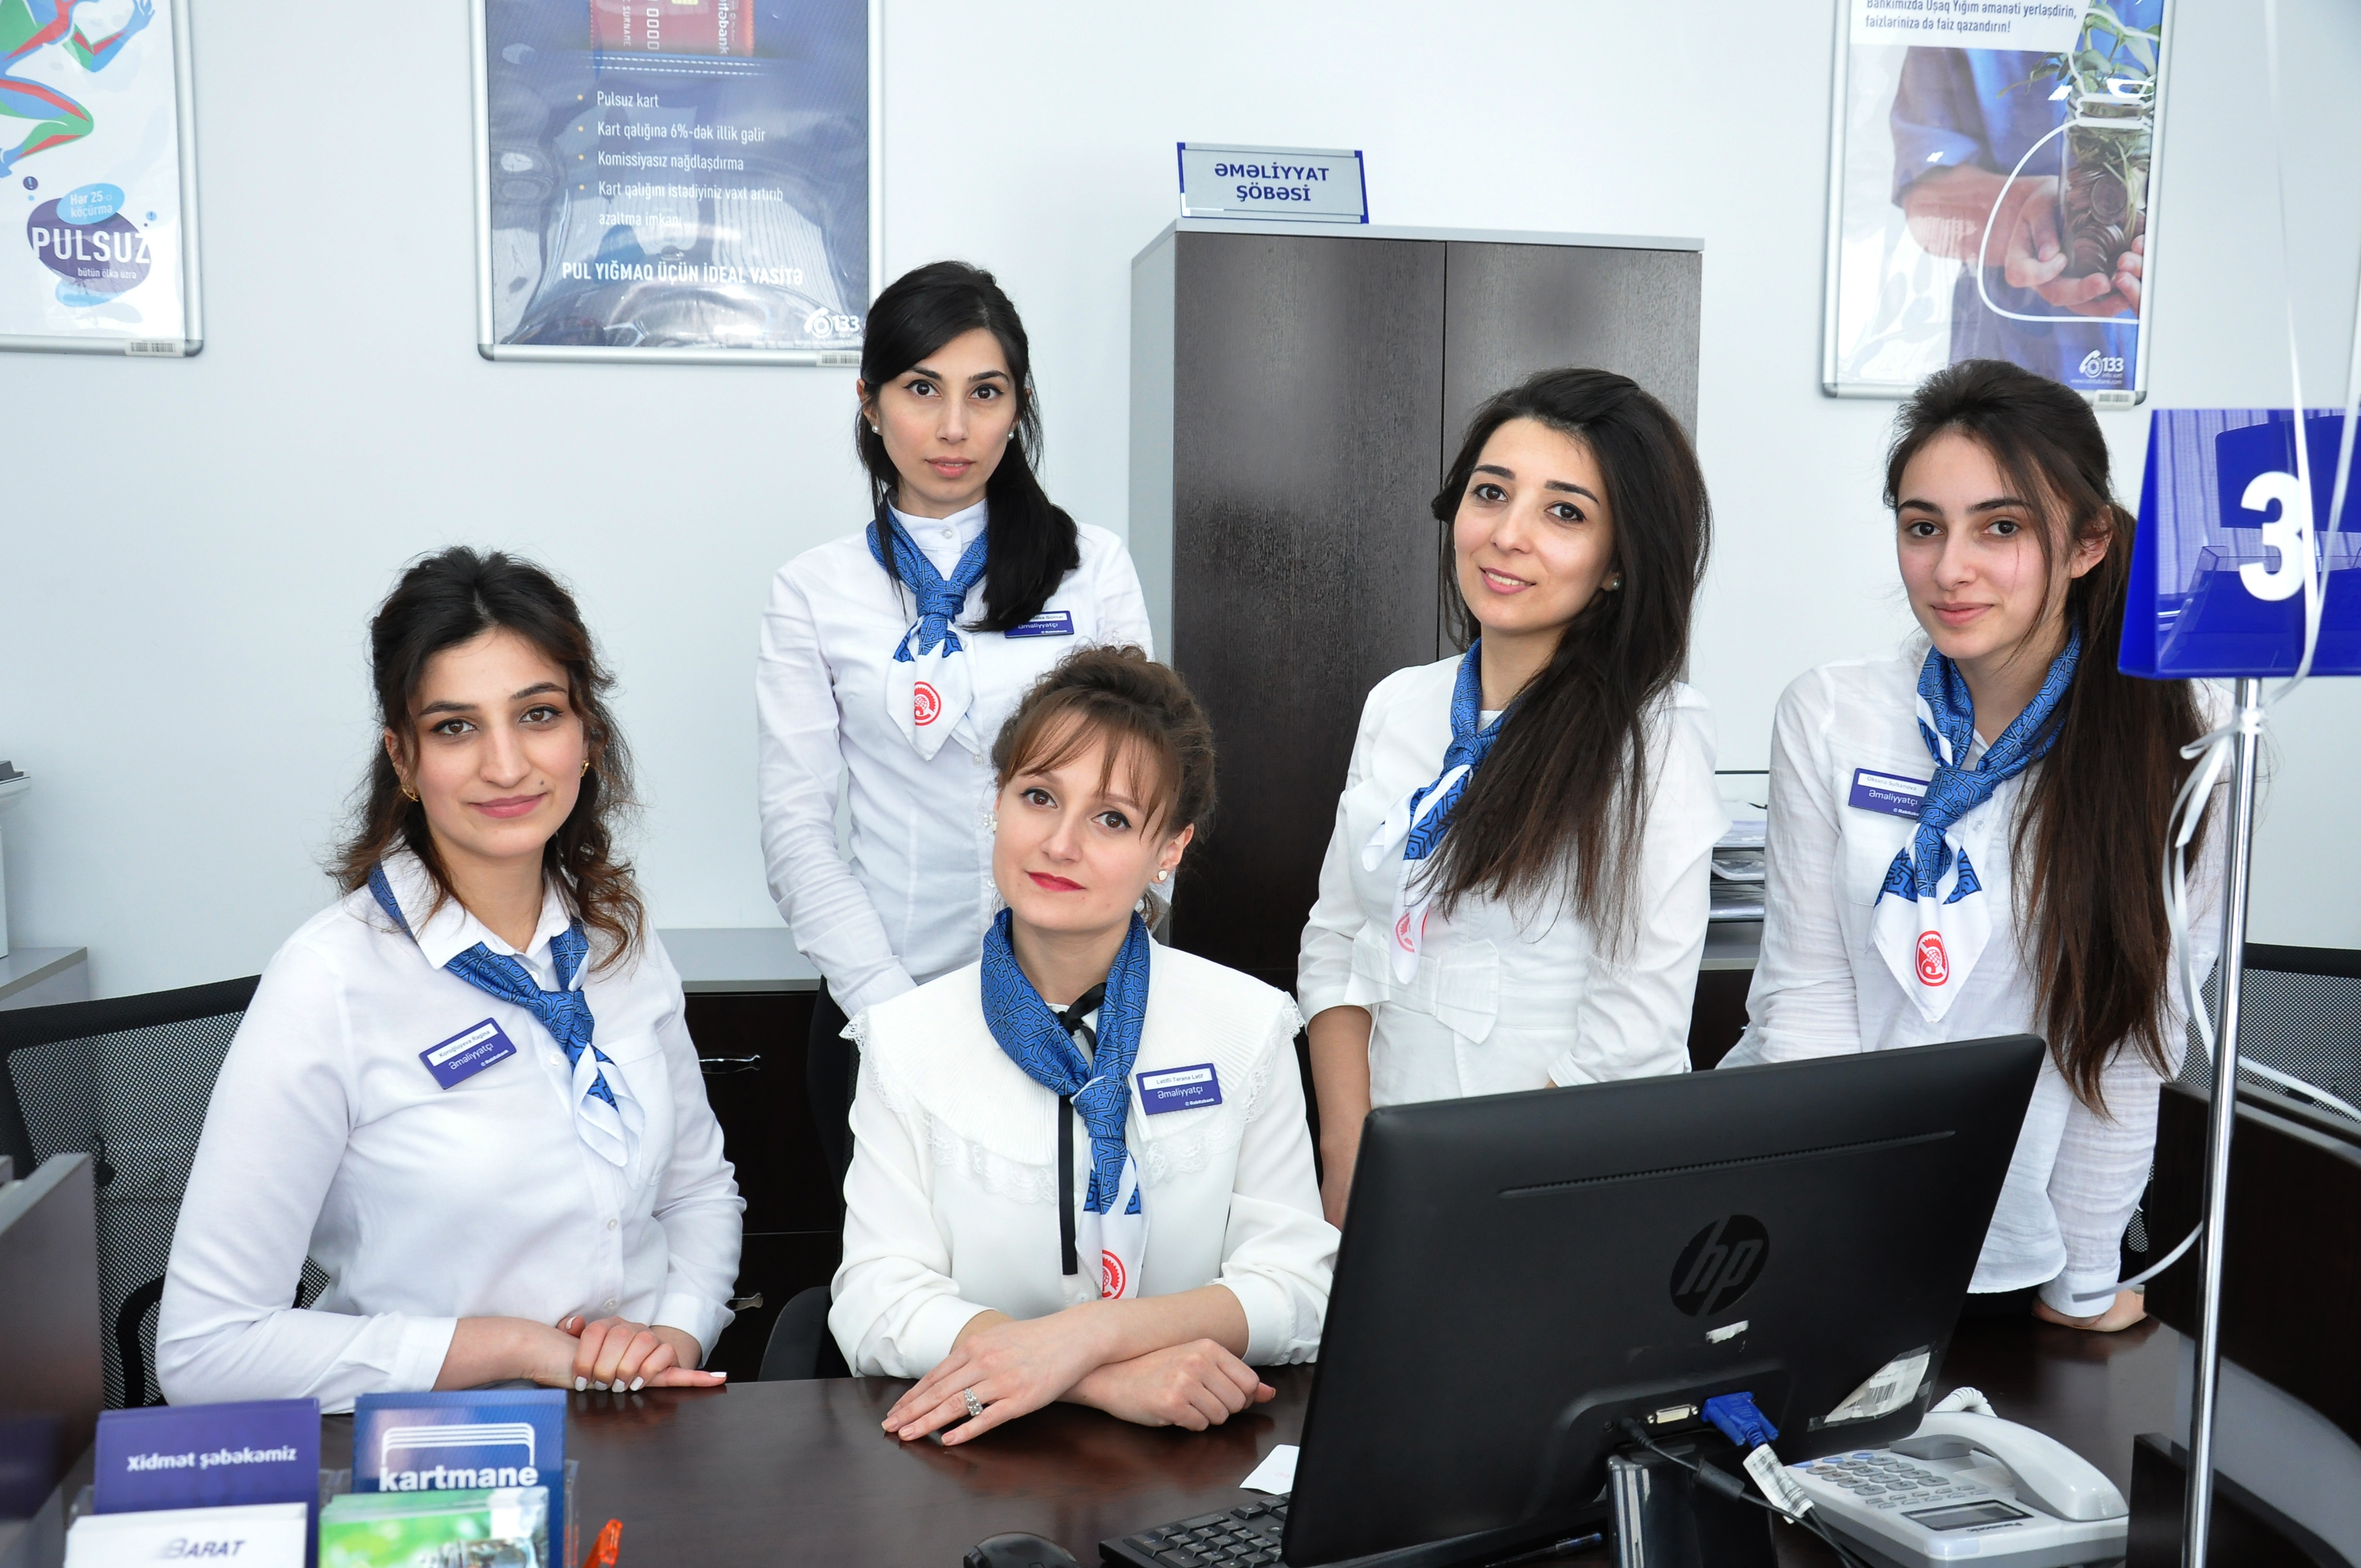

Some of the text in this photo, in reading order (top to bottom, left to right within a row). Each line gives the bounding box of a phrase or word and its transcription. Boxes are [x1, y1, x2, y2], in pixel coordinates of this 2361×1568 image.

[1982, 2, 2021, 15] əmanəti
[2023, 4, 2077, 19] yerləşdirin,
[623, 6, 631, 47] SURNAME
[1865, 15, 2011, 34] faizlərinizə də faiz qazandırın!
[597, 91, 659, 107] Pulsuz kart
[598, 122, 765, 144] Kart qalığına 6%-dək illik gəlir
[598, 151, 744, 172] Komissiyasız nağdlaşdırma
[1214, 161, 1330, 181] ƏMƏLİYYAT
[70, 193, 88, 205] Hər
[599, 181, 784, 202] Kart qalığını istədiyiniz vaxt artırıb
[1236, 182, 1312, 202] ŞÖBƏSİ
[71, 204, 113, 219] köçürmə
[599, 212, 682, 226] azaltma imkanı
[32, 227, 150, 264] PULSUZ
[78, 268, 137, 279] bütün ölkə üzrə
[563, 259, 803, 286] PUL YIĞMAQ ÜÇÜN İDEAL VASİTƏ
[832, 315, 860, 332] 133
[2103, 357, 2124, 372] 133
[2239, 471, 2308, 601] 3
[1867, 776, 1917, 791] Oksana Sultanova
[1869, 790, 1918, 807] Əməliyyatçı
[448, 1043, 494, 1070] Əməliyyatçı
[1157, 1086, 1204, 1099] Əməliyyatçı
[1673, 1215, 1765, 1316] hp
[199, 1445, 297, 1471] şəbəkəmiz
[379, 1464, 538, 1493] kartmane
